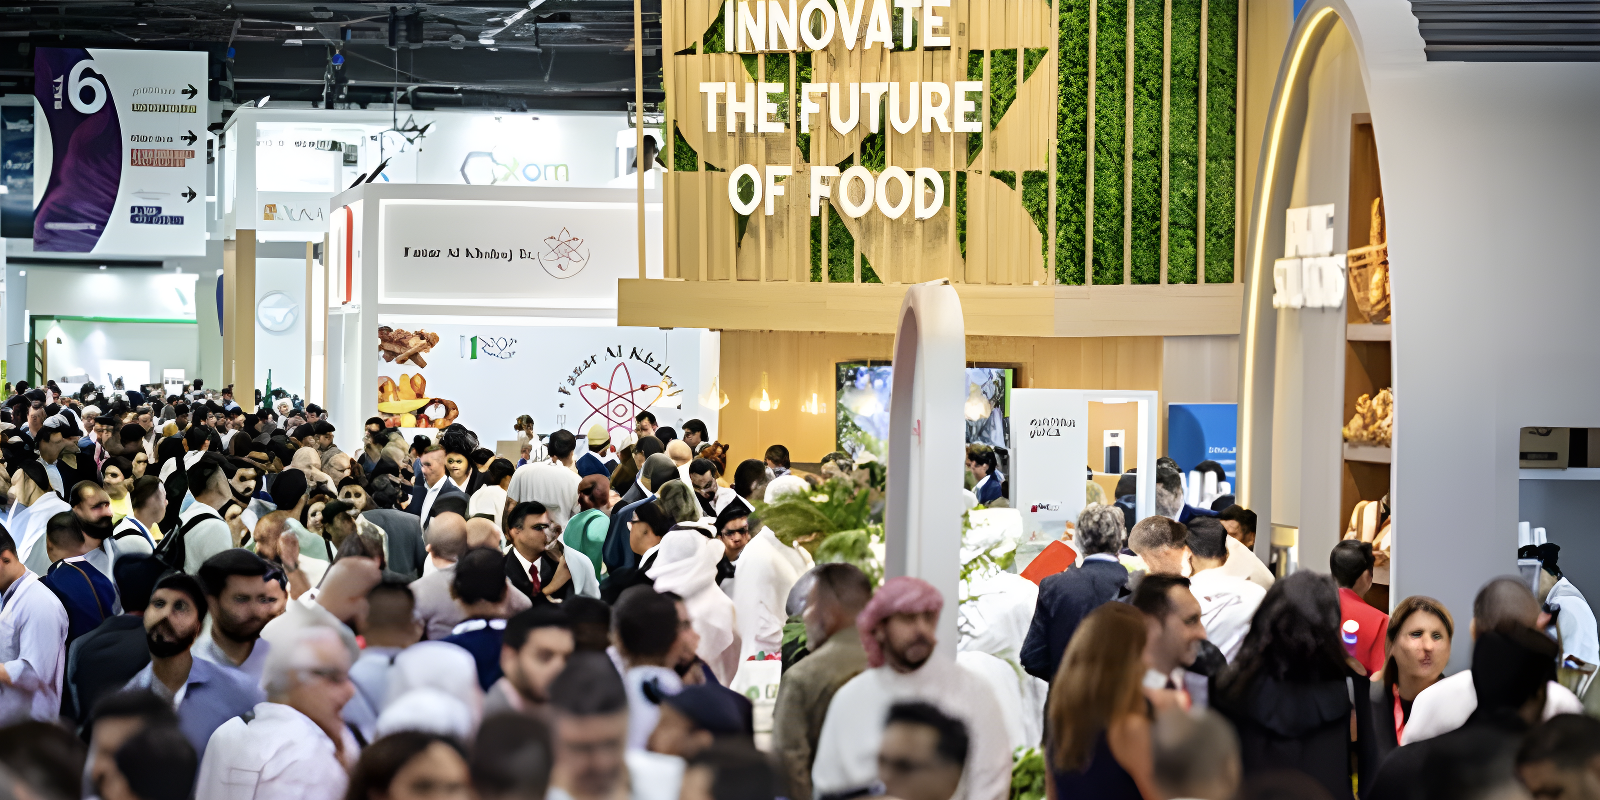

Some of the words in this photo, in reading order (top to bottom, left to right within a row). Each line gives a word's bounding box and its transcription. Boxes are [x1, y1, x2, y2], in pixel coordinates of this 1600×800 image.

[724, 0, 951, 52] INNOVATE
[68, 59, 107, 115] 6
[699, 81, 785, 133] THE
[800, 81, 983, 135] FUTURE
[728, 163, 792, 216] OF
[809, 165, 945, 220] FOOD
